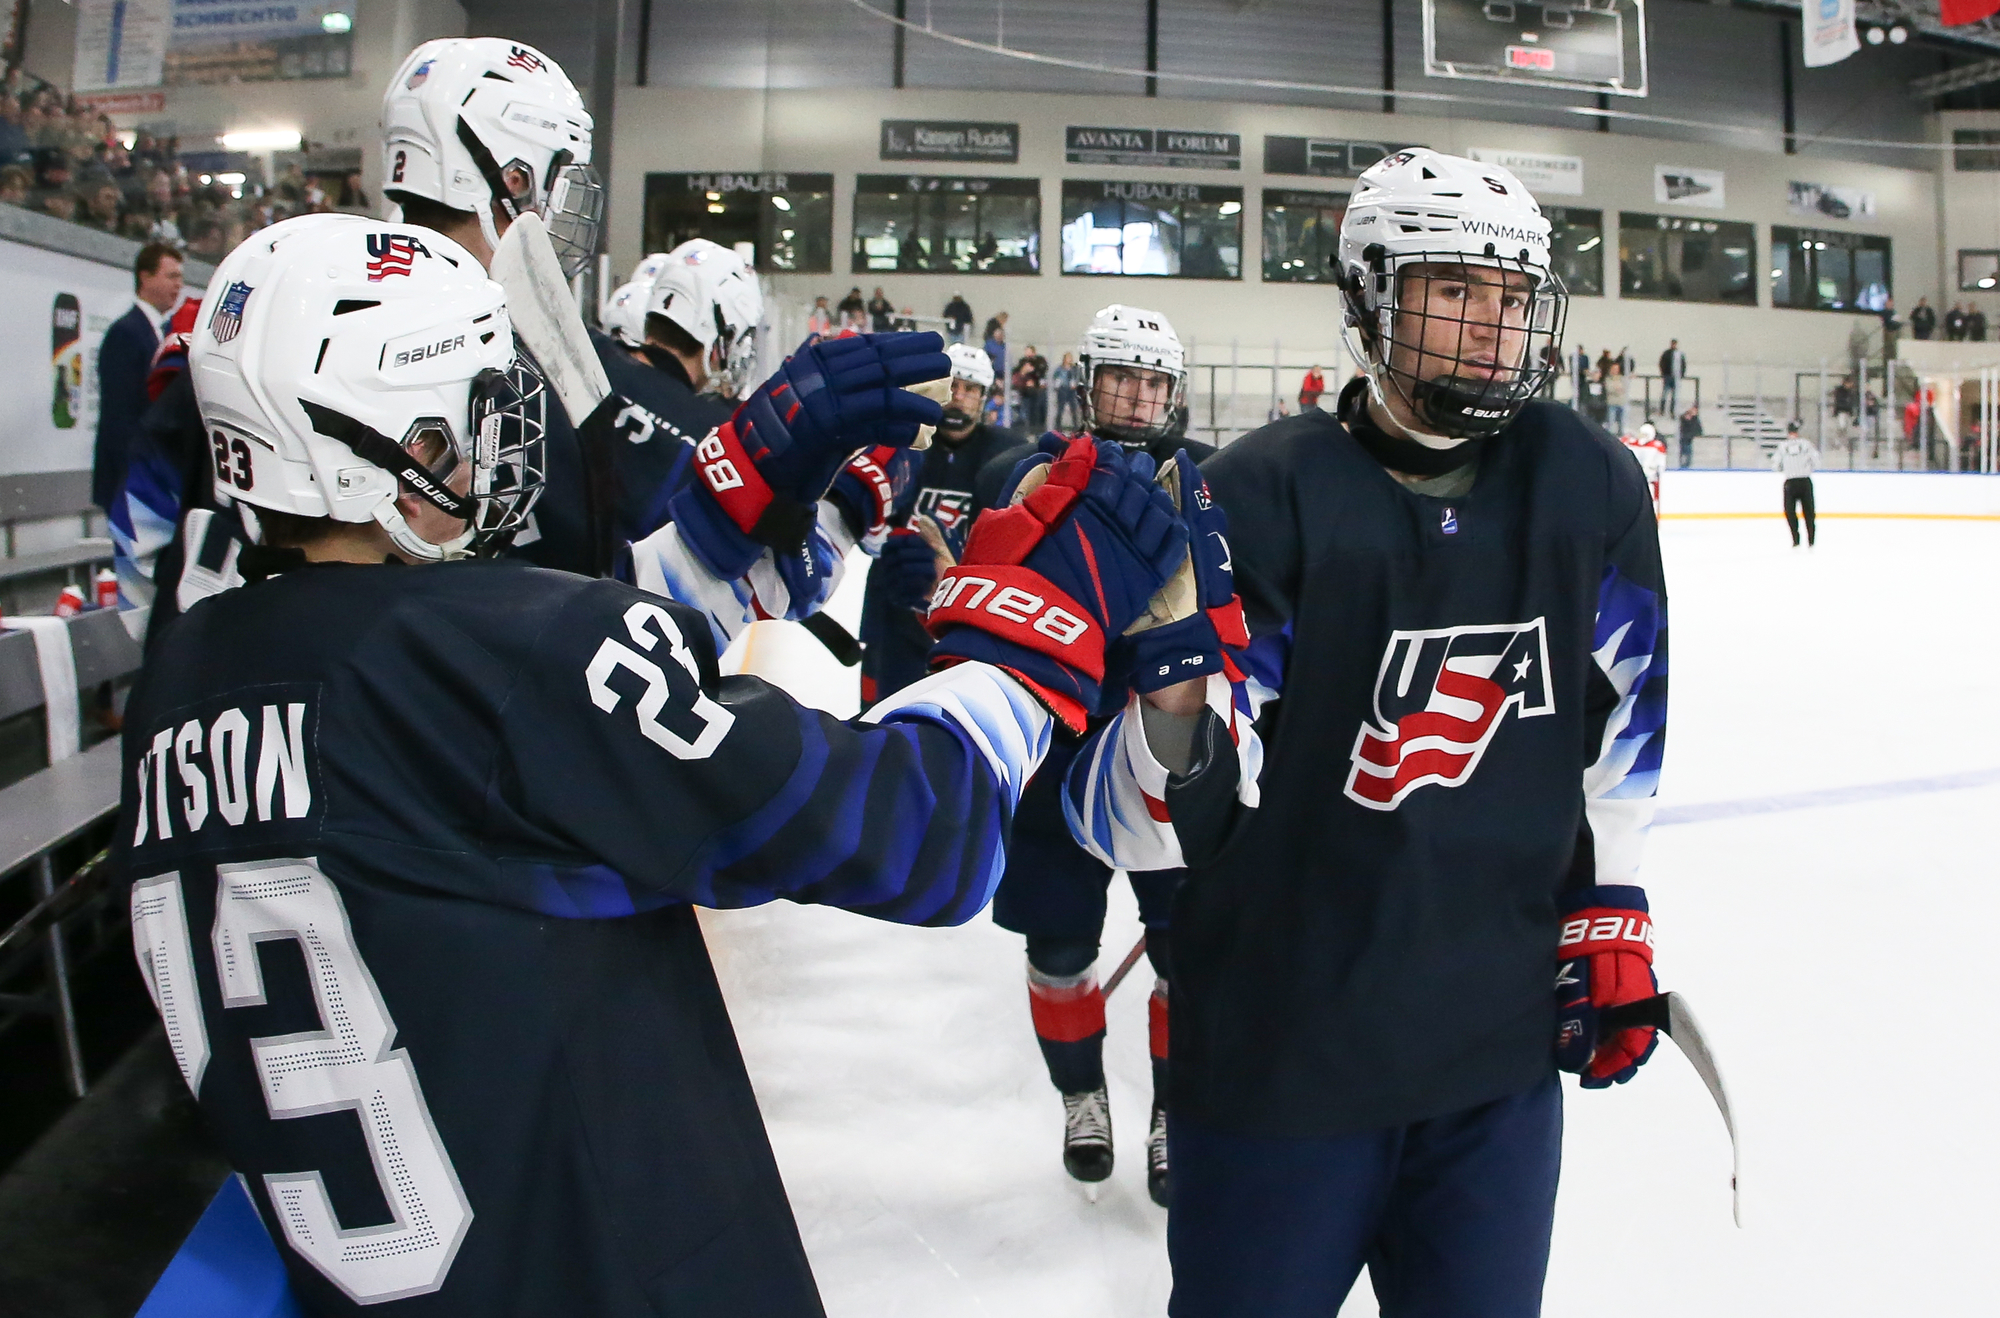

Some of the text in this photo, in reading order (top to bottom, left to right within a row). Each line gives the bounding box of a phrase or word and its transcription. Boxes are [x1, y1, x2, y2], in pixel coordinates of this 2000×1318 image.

[1074, 131, 1230, 152] AVANTA FORUM
[392, 150, 407, 183] 2
[687, 173, 789, 193] HUBAUER
[1103, 182, 1200, 201] HUBAUER
[1461, 220, 1547, 247] WINMARK
[366, 233, 432, 283] USA
[394, 334, 466, 368] BAUER
[212, 430, 255, 492] 23
[401, 468, 460, 511] BAUER
[1343, 616, 1556, 812] USA
